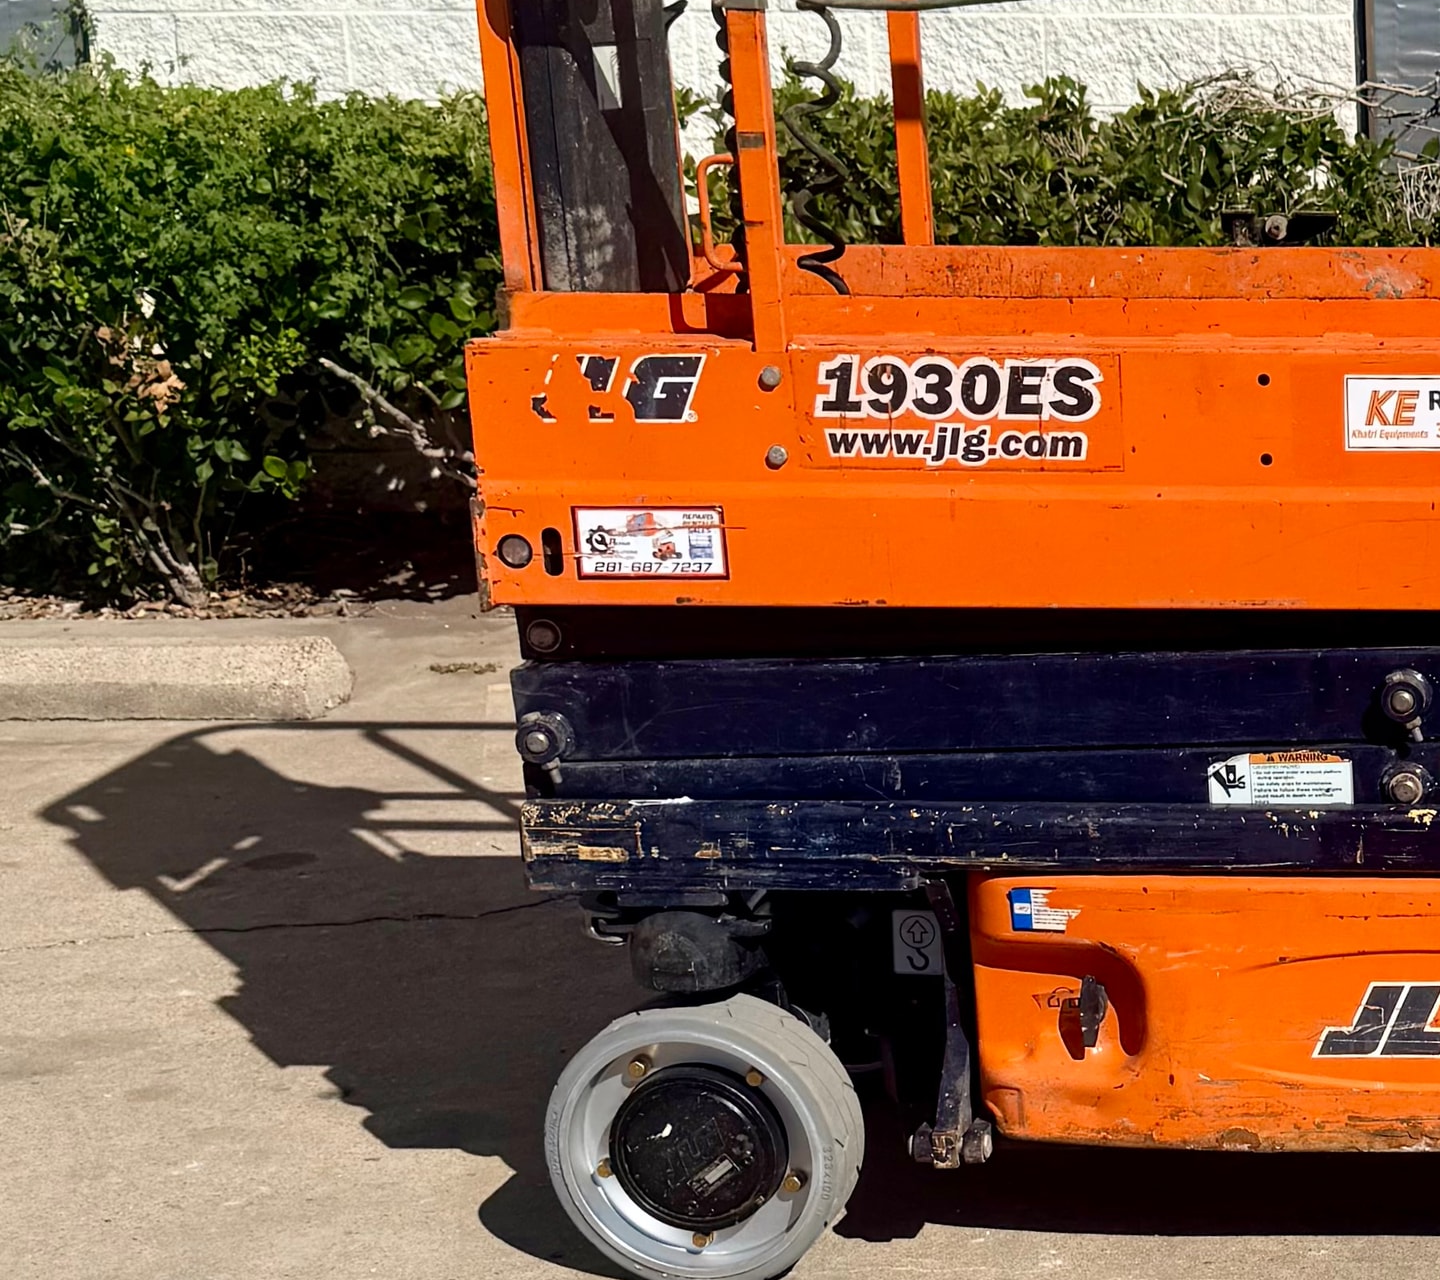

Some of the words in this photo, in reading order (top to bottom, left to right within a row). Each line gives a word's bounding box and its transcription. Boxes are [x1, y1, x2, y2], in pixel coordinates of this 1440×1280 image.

[531, 353, 707, 423] LG
[819, 359, 1096, 417] 1930ES
[1365, 390, 1420, 426] KE
[827, 425, 1083, 463] www.jlg.com
[594, 561, 713, 573] 281-687-7237
[1277, 751, 1328, 763] WARNING
